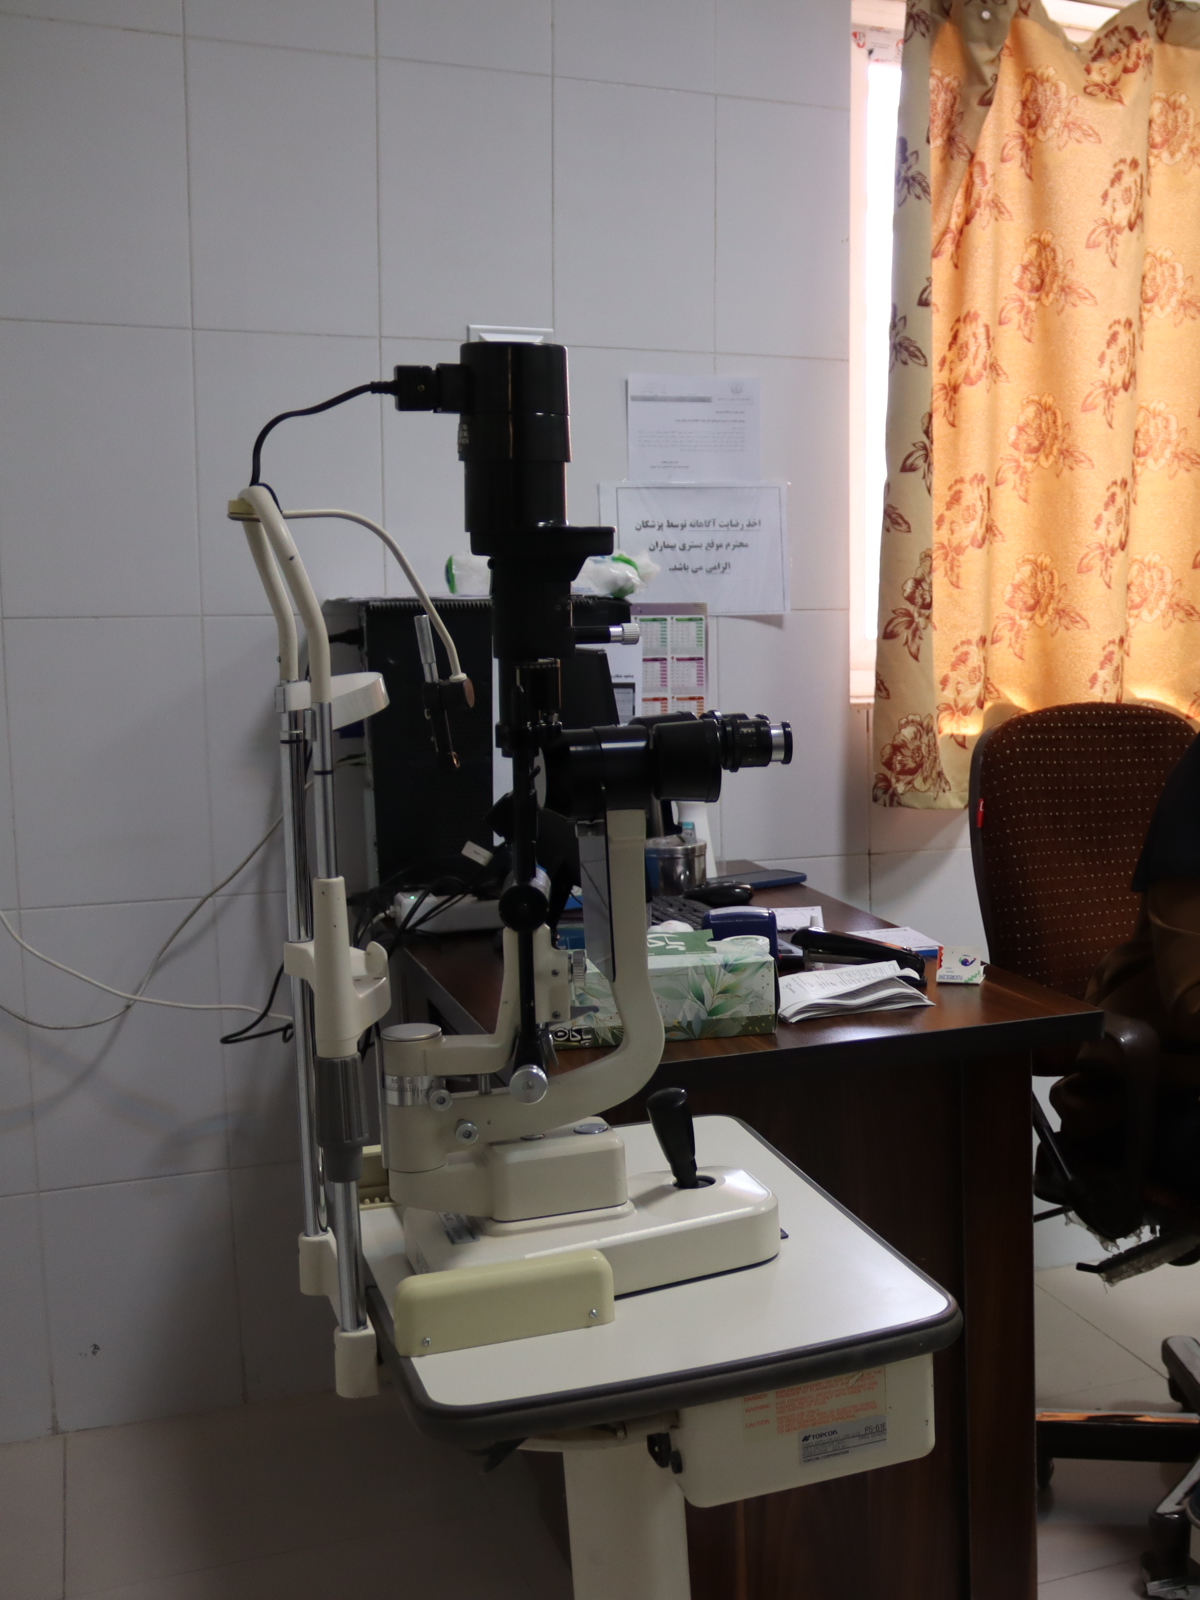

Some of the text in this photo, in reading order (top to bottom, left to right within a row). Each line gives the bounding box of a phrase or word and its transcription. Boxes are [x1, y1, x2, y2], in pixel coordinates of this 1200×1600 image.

[634, 518, 762, 531] اخذ رضایت آگاهانه توسط پزشکان
[648, 539, 749, 552] محترم موقع بستری بیماران
[690, 565, 703, 573] می
[705, 562, 731, 573] الزامی
[745, 1418, 770, 1429] CAUTION
[864, 1422, 886, 1434] PS-61E
[812, 1429, 838, 1440] TOPCON
